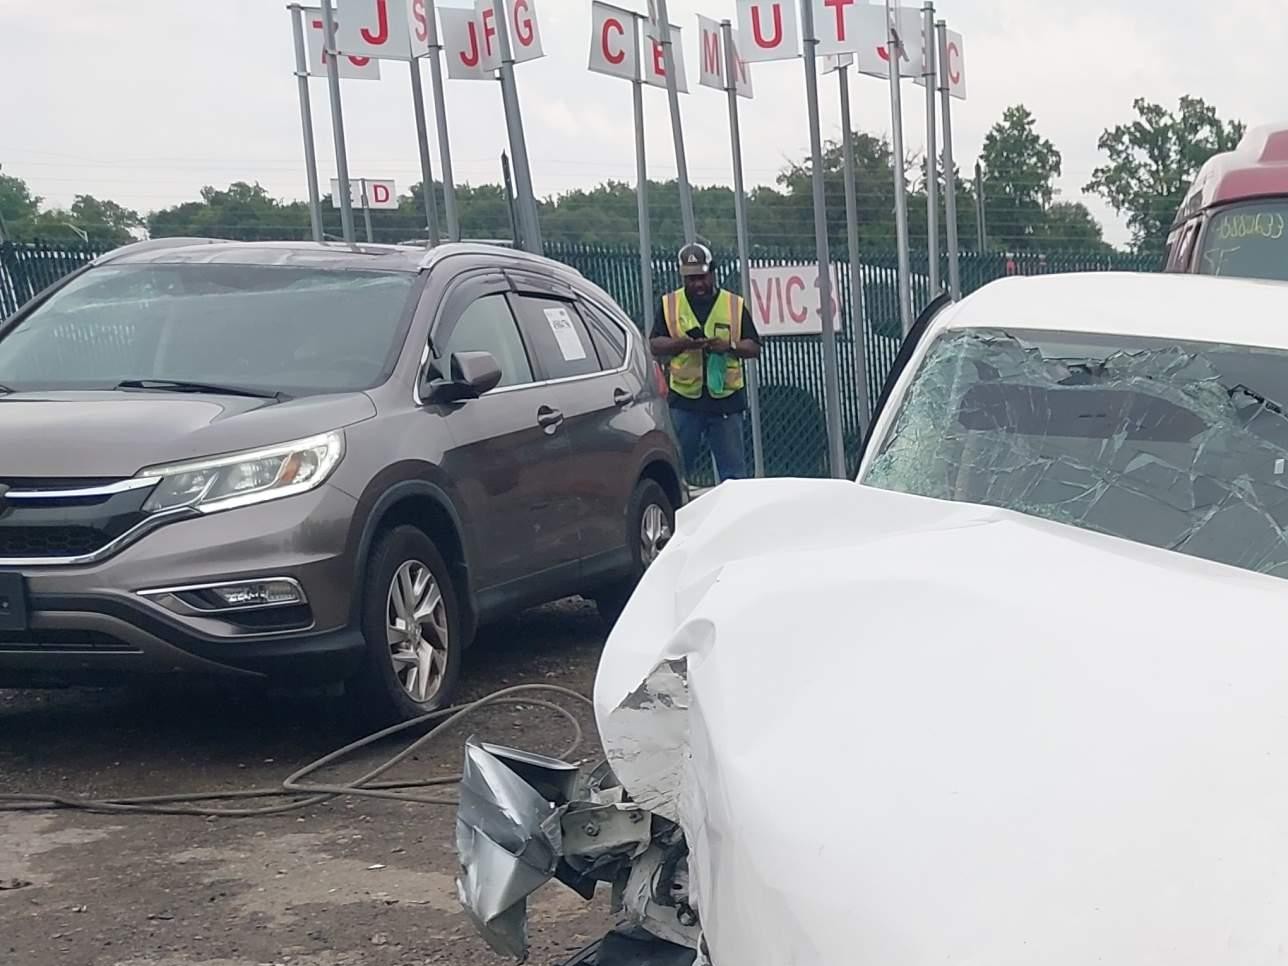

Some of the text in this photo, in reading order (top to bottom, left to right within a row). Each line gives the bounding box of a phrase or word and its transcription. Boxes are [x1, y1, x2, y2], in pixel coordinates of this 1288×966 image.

[360, 0, 388, 45] J
[459, 21, 479, 67] J
[482, 0, 534, 56] F G
[602, 18, 625, 65] C
[751, 0, 855, 49] U T
[703, 29, 720, 77] M
[373, 184, 390, 203] D
[751, 276, 808, 325] VIC
